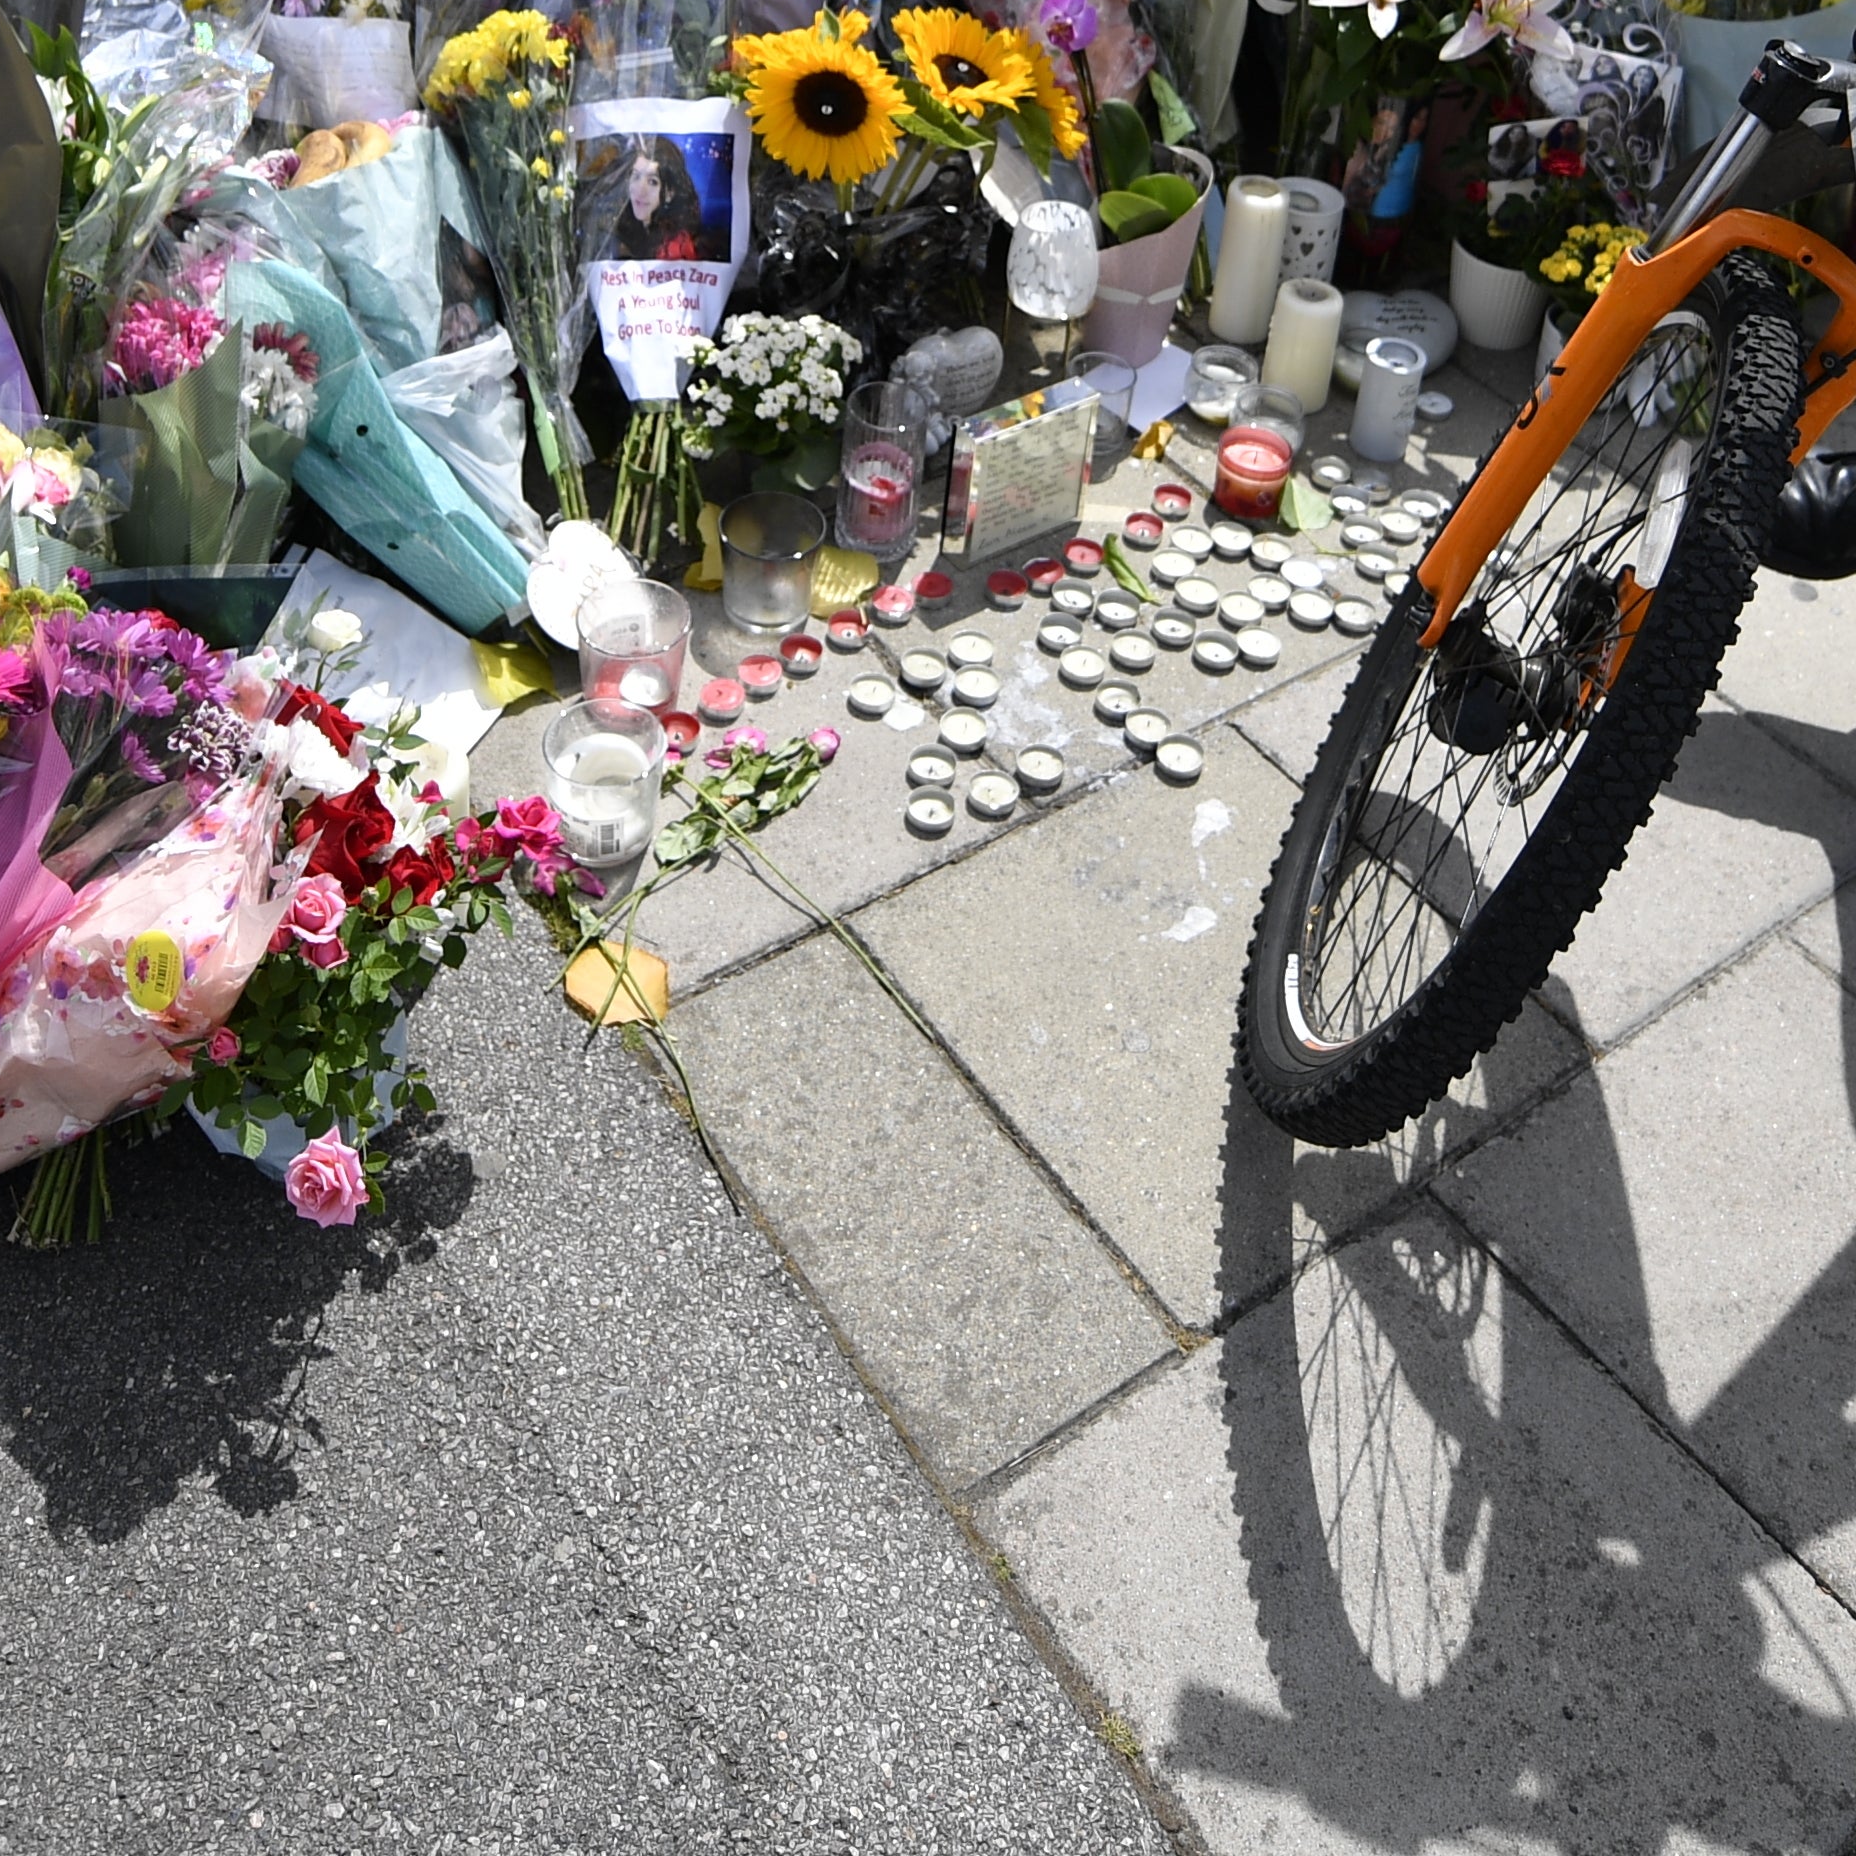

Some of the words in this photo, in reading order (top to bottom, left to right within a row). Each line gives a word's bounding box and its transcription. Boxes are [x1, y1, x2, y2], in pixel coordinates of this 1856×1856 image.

[601, 270, 628, 286] Rest
[632, 270, 644, 284] In
[647, 269, 685, 285] Peace
[688, 267, 718, 286] Zara
[618, 297, 626, 312] A
[631, 294, 673, 310] Young
[677, 292, 700, 310] Soul
[618, 323, 652, 341] Gone
[656, 319, 672, 334] To
[675, 320, 701, 337] Soon
